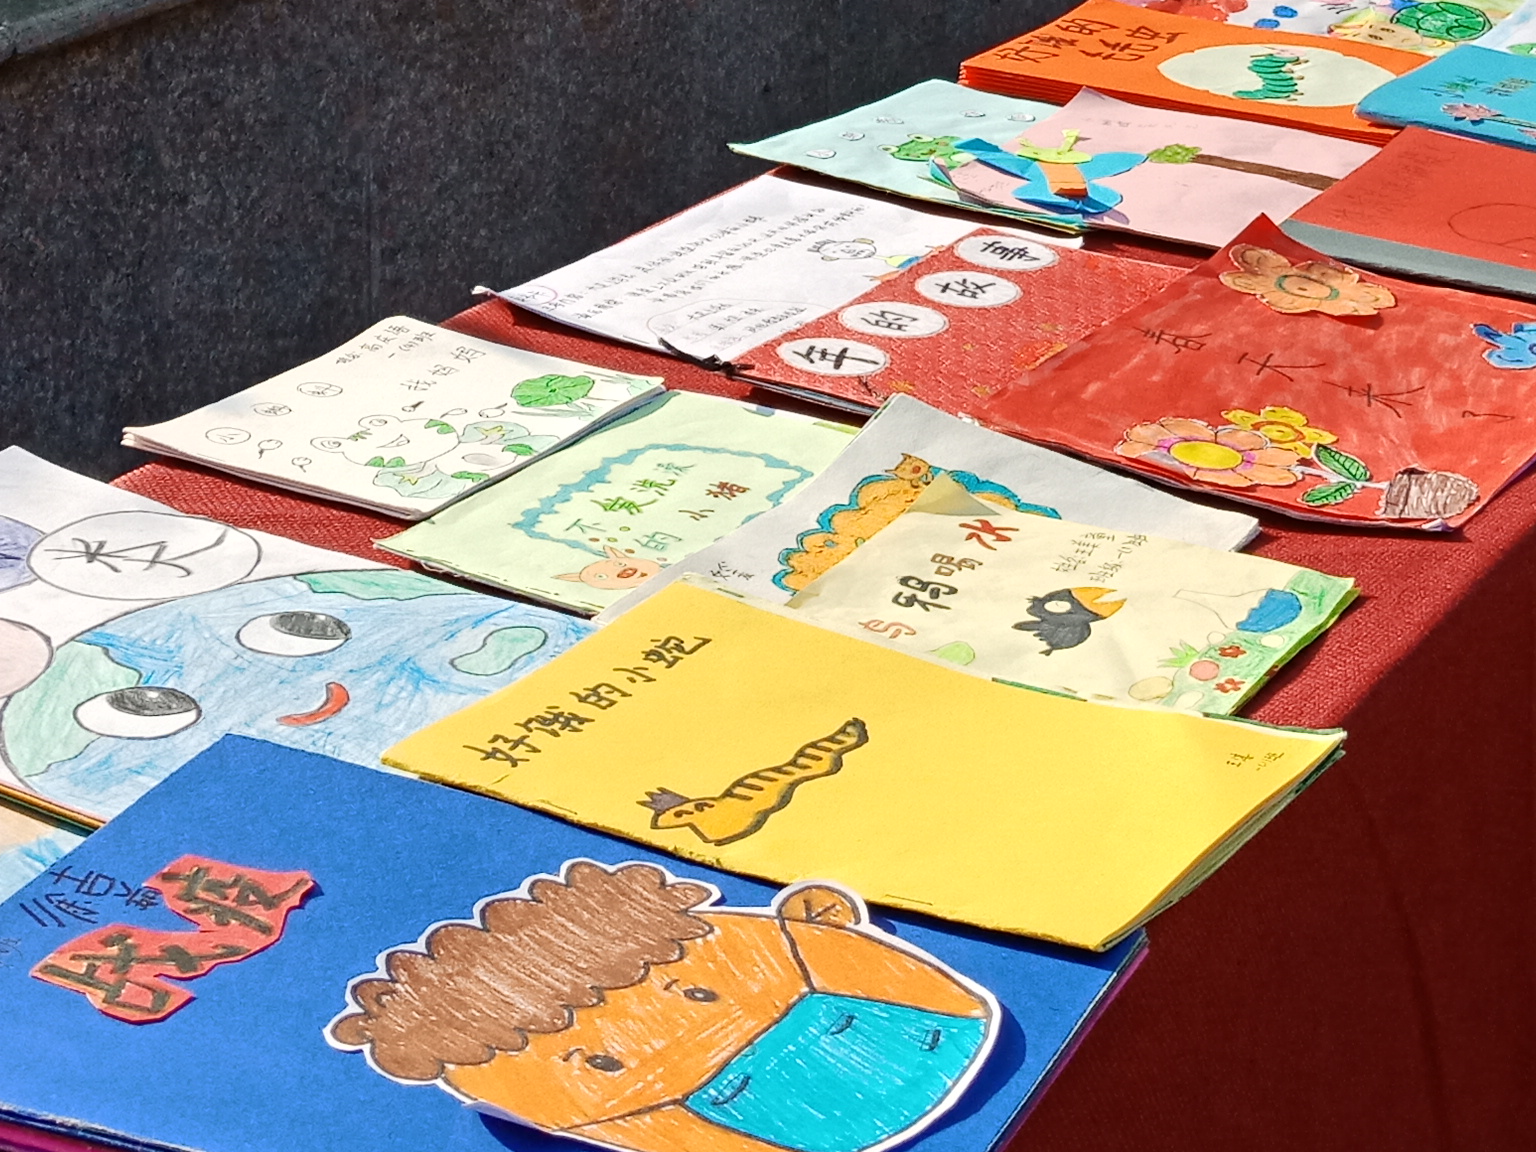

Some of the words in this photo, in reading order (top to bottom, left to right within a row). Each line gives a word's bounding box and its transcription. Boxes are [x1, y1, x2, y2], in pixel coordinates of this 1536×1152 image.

[792, 240, 1041, 370] 年的故事
[1132, 326, 1516, 424] 春天来了
[634, 480, 752, 552] 的小猪
[858, 519, 1020, 639] 乌鸦喝水
[462, 635, 713, 768] 好饿的小蛇
[38, 865, 312, 1014] 战疫
